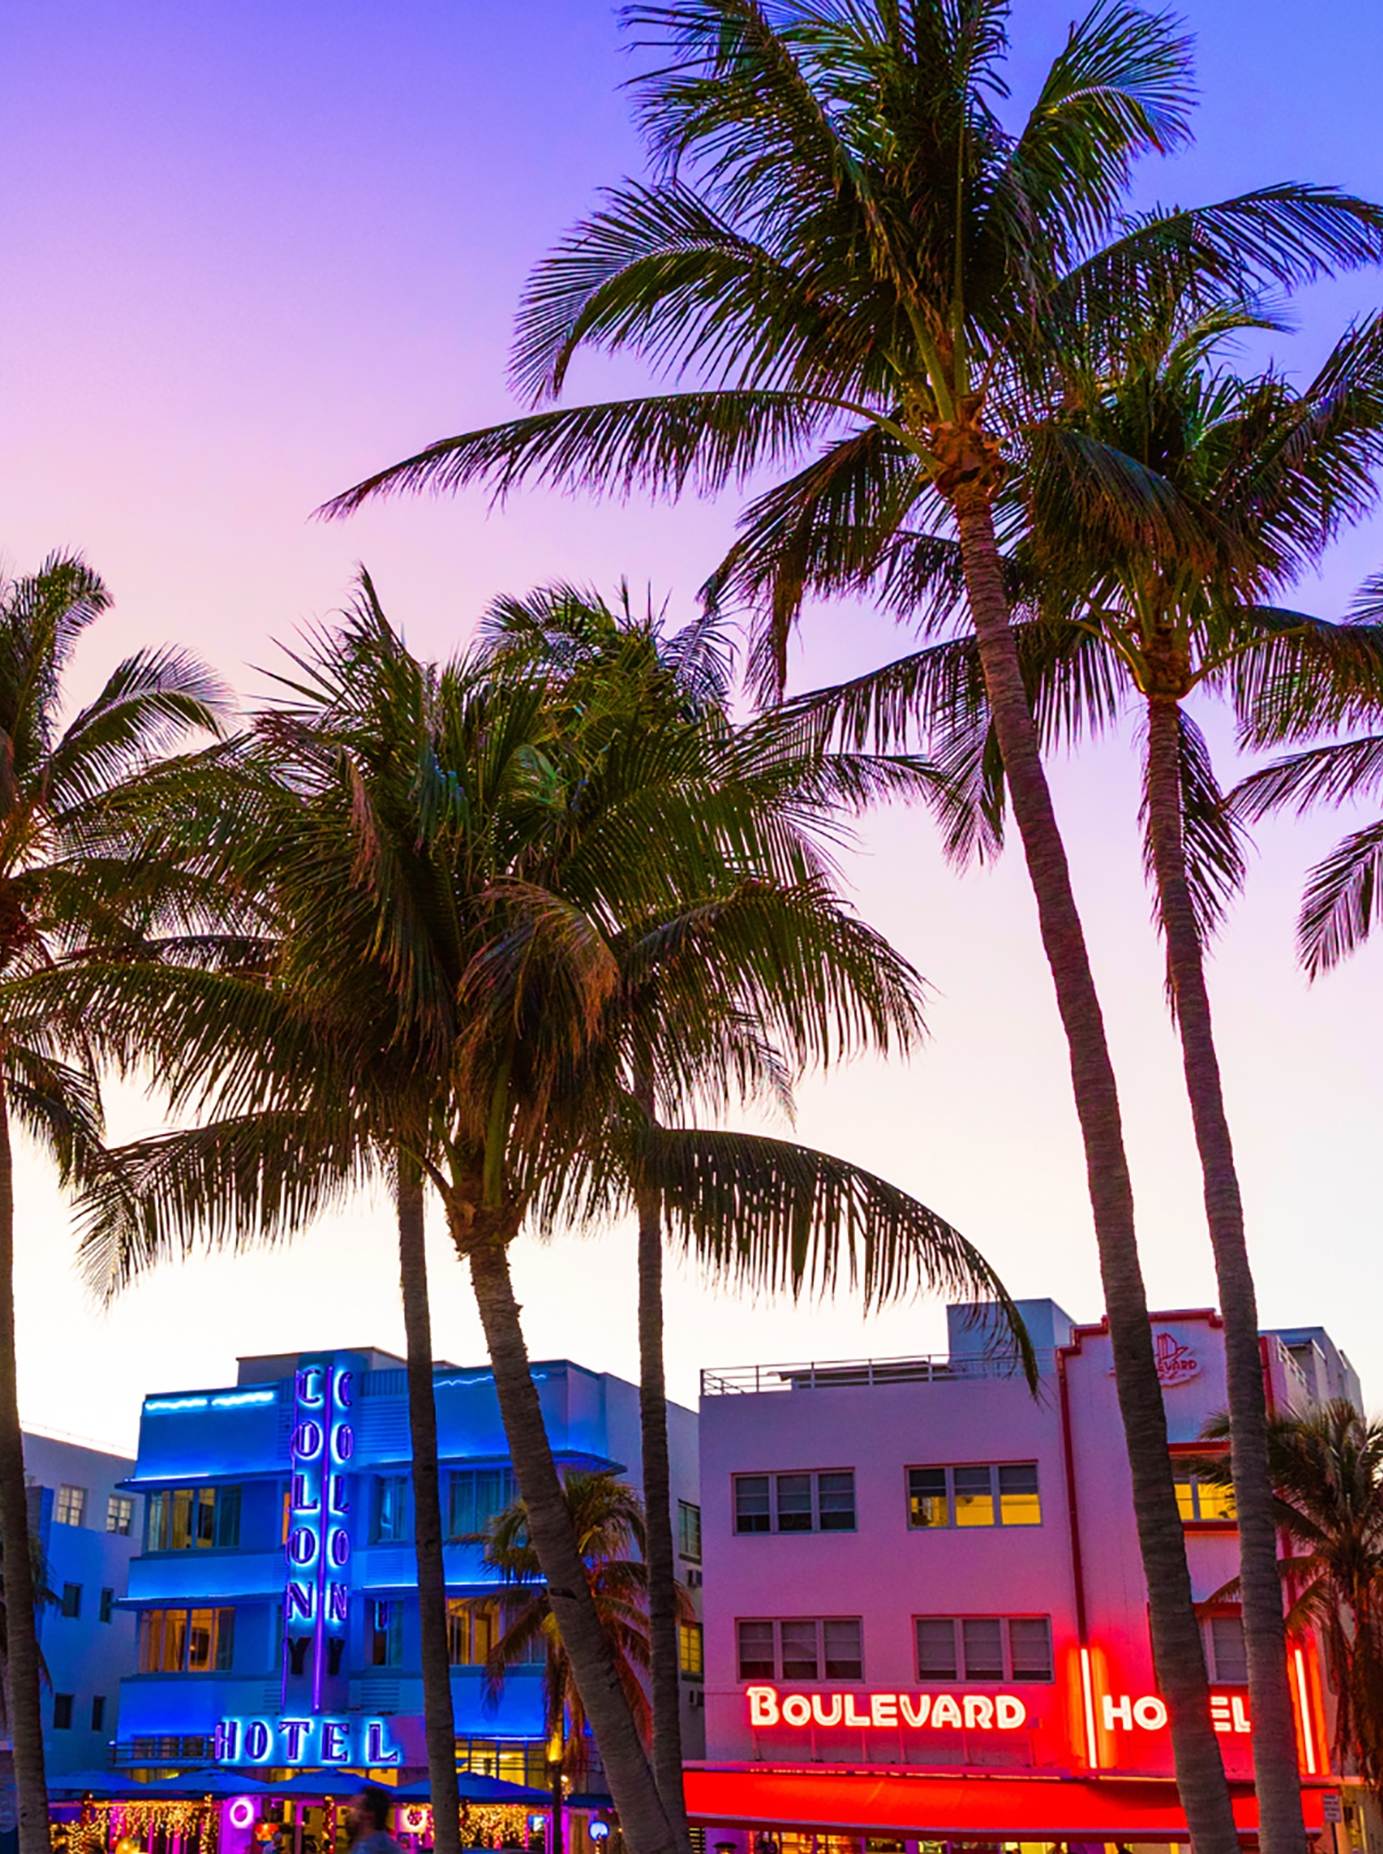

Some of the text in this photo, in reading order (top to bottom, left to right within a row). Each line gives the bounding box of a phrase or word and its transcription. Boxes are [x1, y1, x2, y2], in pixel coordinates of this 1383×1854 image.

[284, 1368, 321, 1676] COLONY
[328, 1371, 354, 1676] COLONY
[215, 1720, 400, 1763] HOTEL
[747, 1686, 1251, 1733] BOULEVARD HOEL
